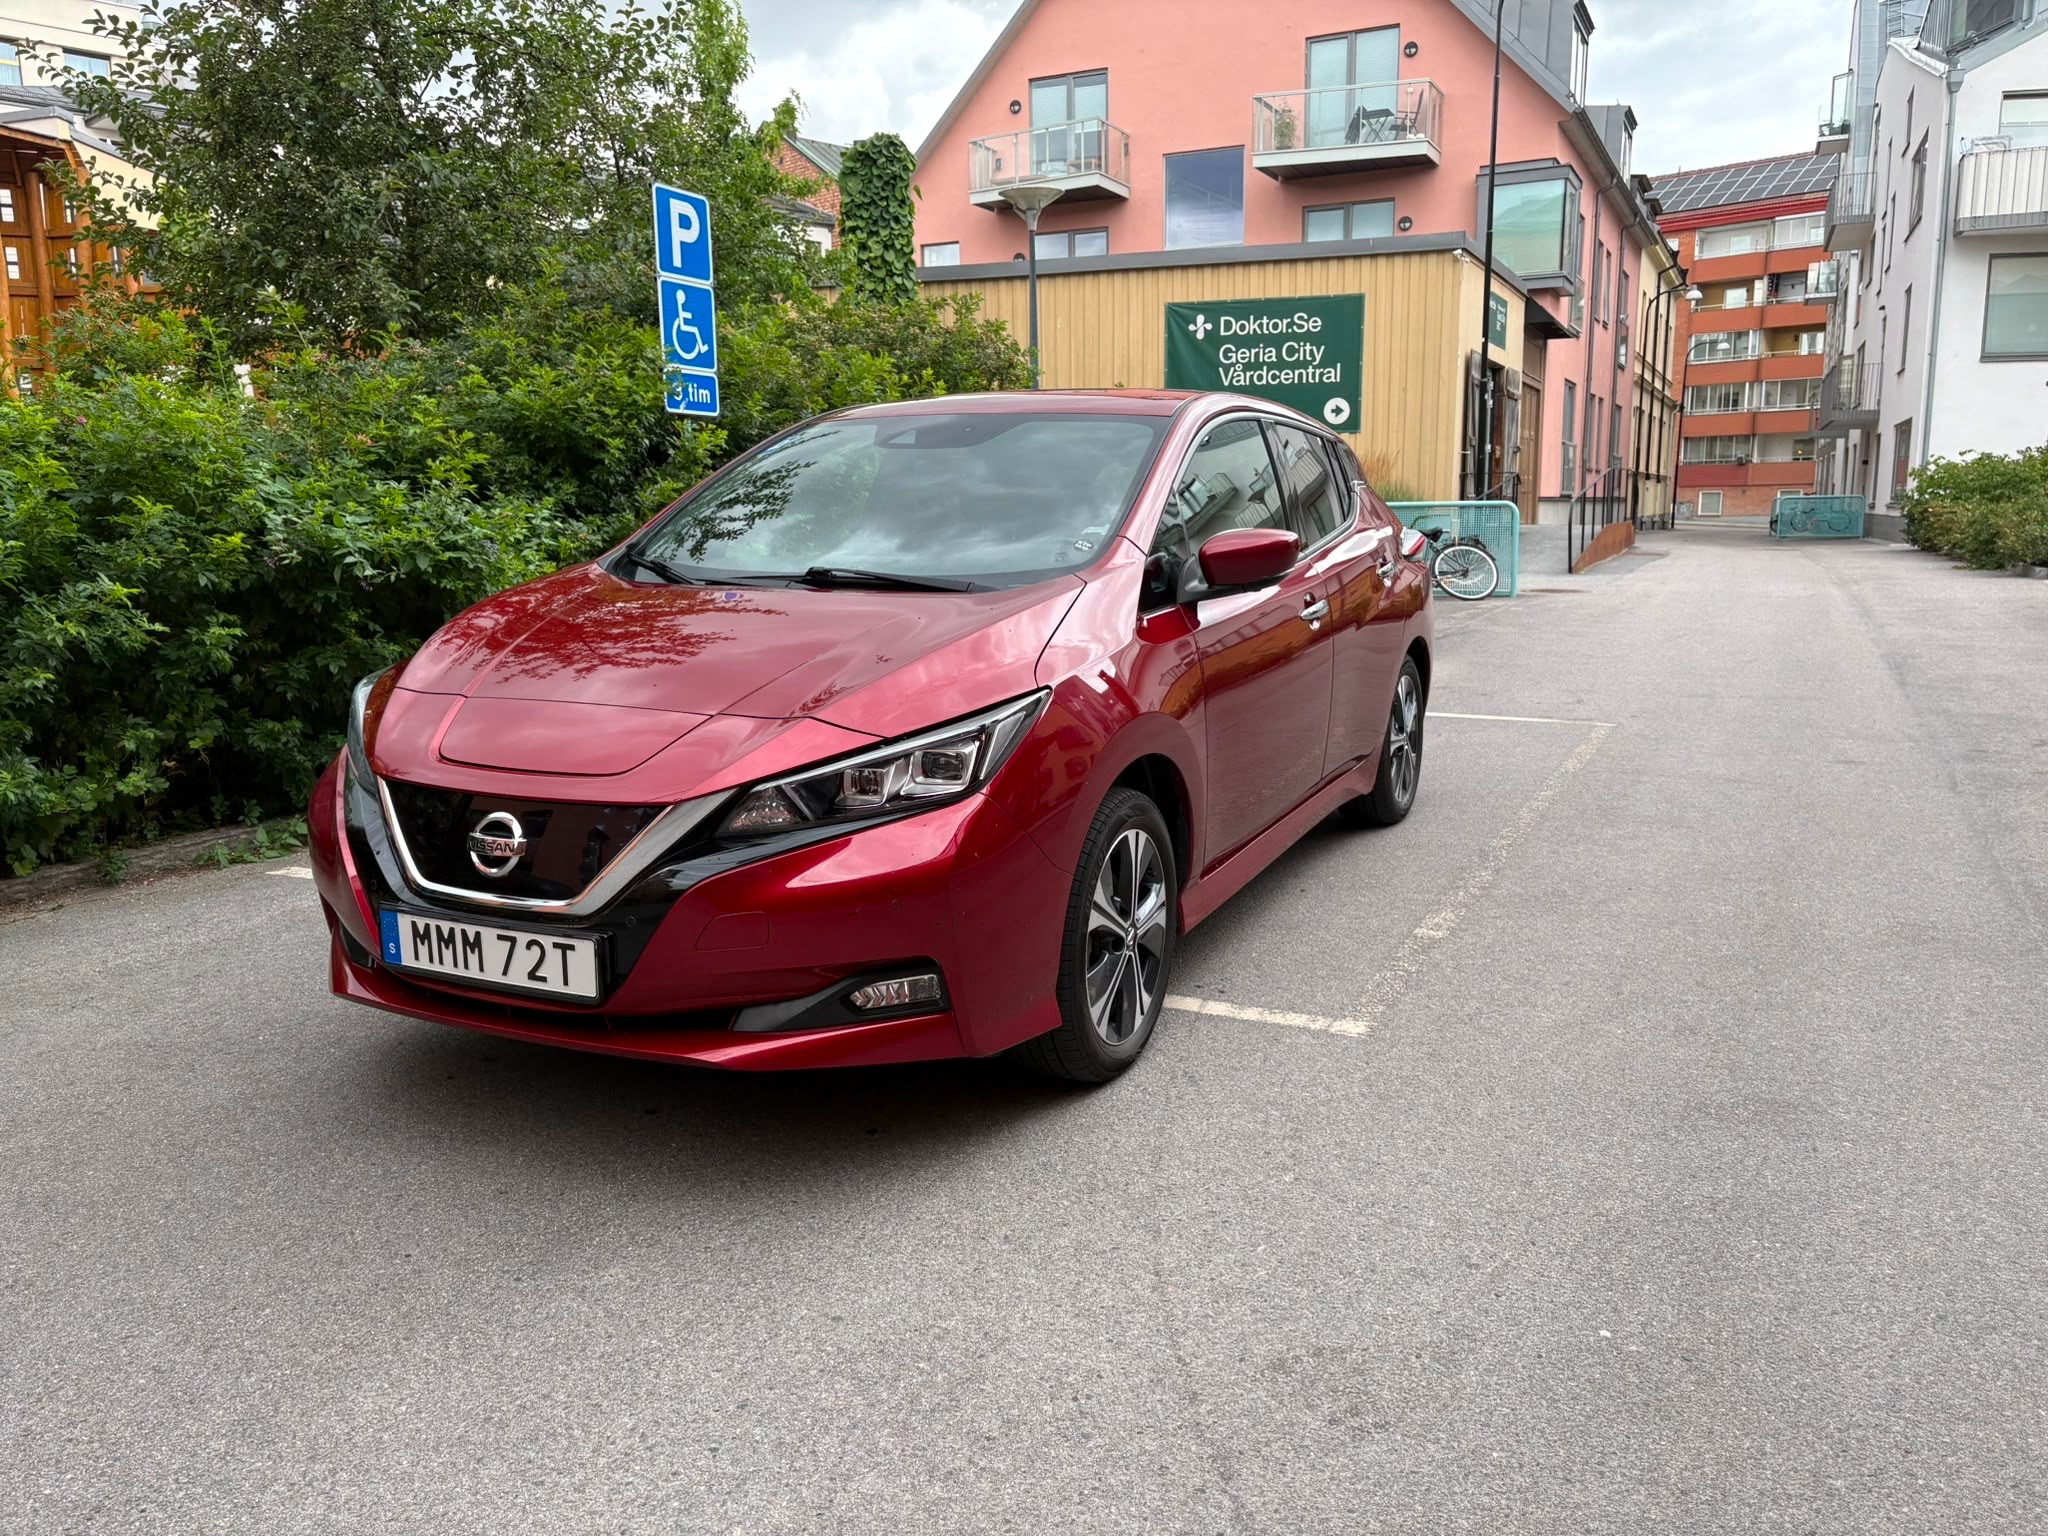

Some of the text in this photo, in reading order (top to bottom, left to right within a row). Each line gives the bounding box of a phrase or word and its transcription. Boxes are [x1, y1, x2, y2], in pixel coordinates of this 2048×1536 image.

[669, 198, 700, 268] P
[1220, 313, 1322, 336] Doktor.Se
[1219, 342, 1325, 365] Geria City
[1218, 363, 1341, 386] Vårdcentral
[688, 383, 711, 404] tim
[467, 839, 515, 853] NISSAN
[389, 942, 396, 955] S
[411, 920, 576, 987] MMM 72T
